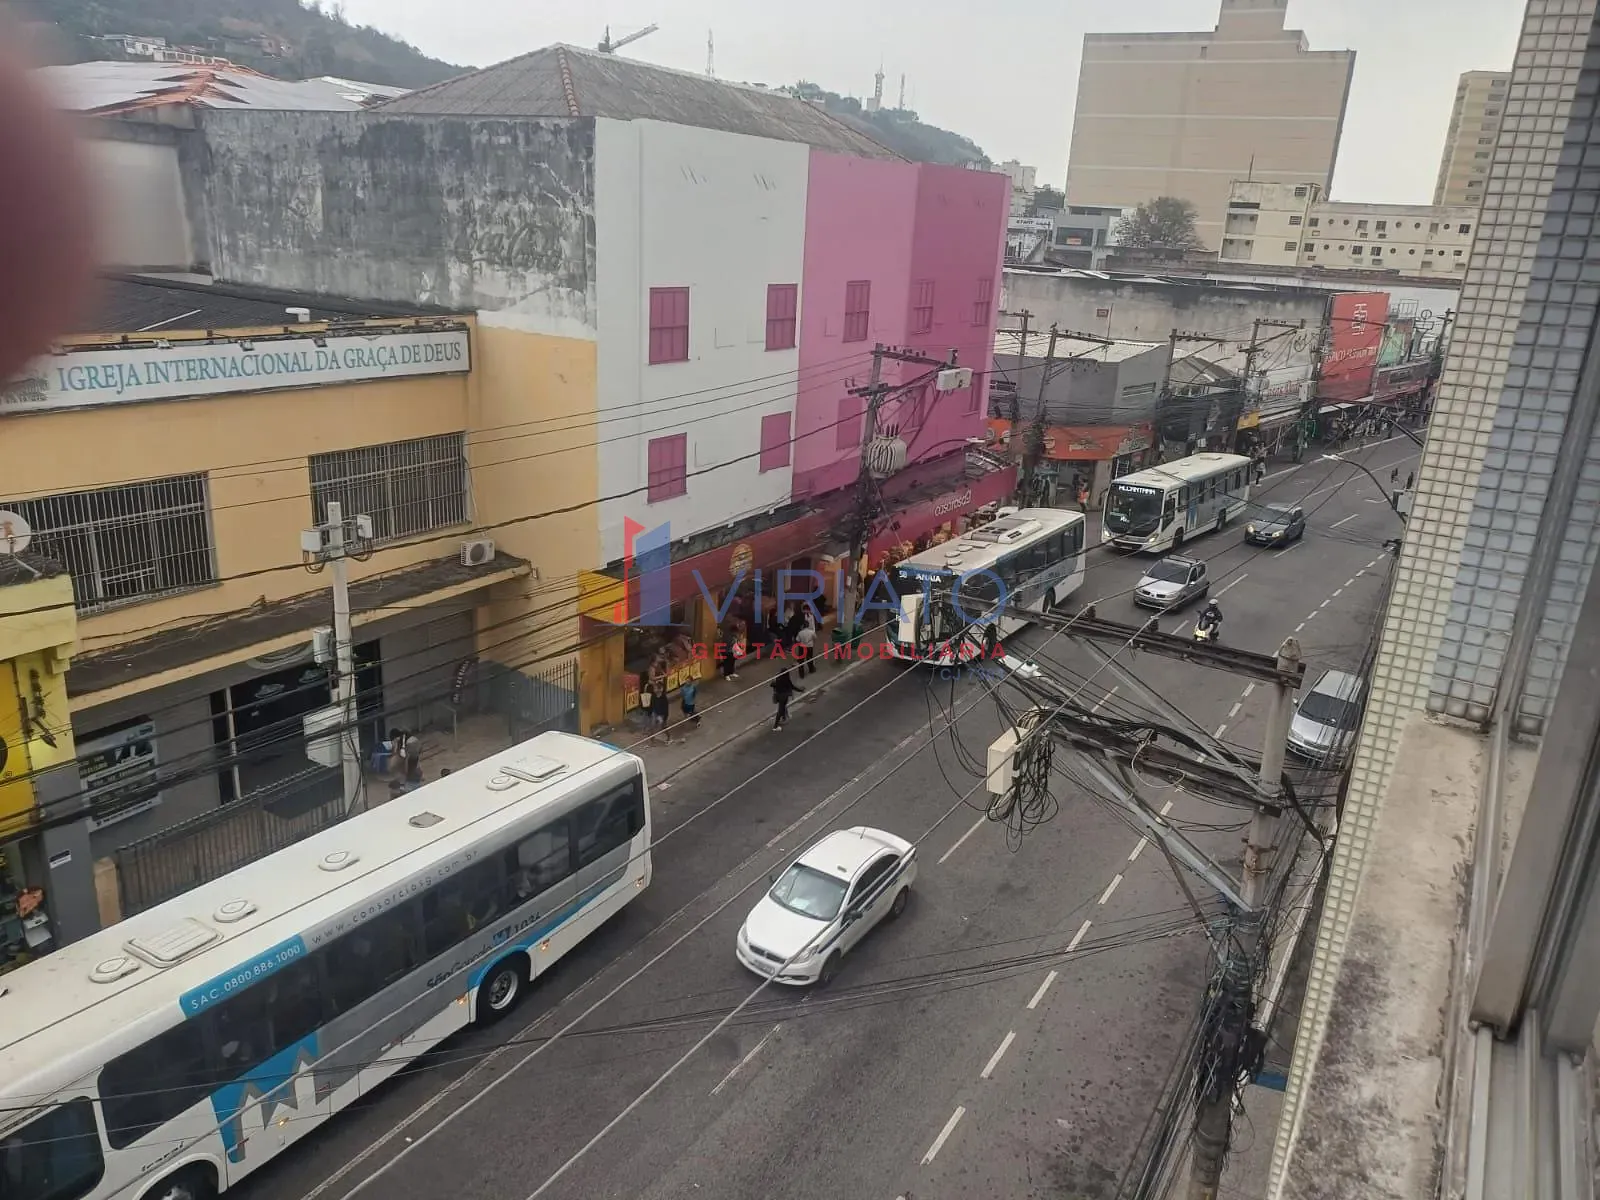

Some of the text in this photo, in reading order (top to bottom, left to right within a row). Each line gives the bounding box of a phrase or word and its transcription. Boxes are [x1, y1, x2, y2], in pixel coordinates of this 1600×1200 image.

[57, 342, 461, 395] IGREJA INTERNACIONAL DA GRAÇA DE DEUS
